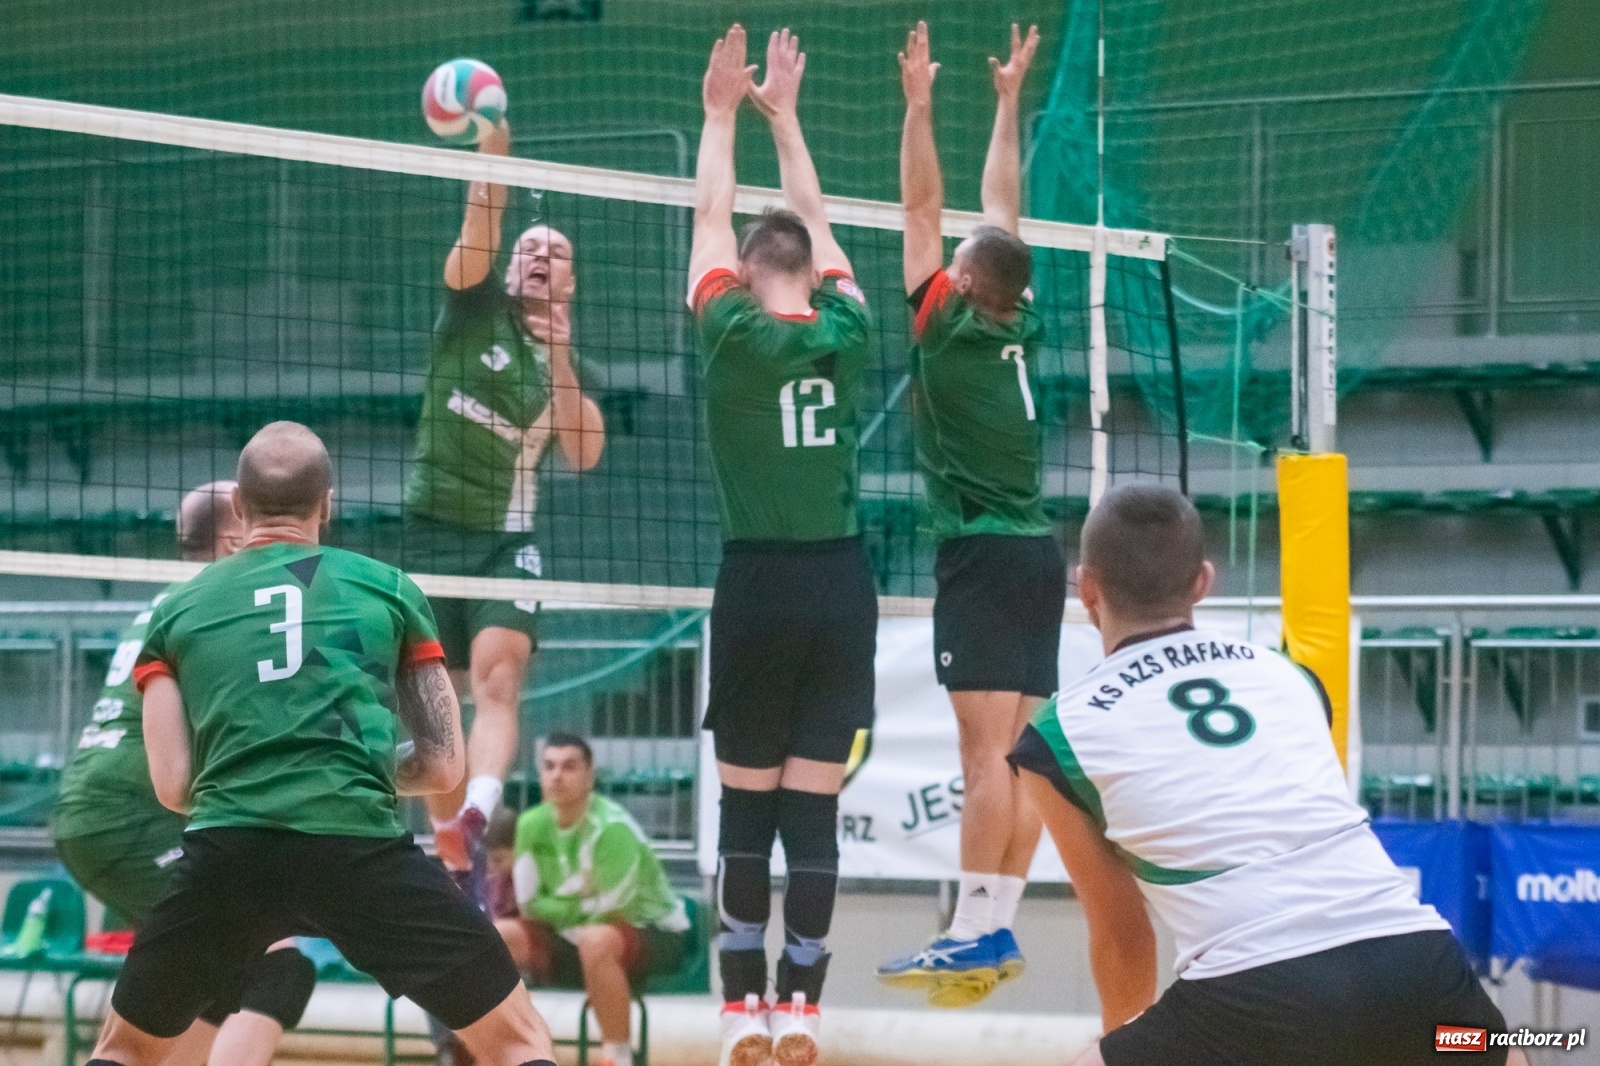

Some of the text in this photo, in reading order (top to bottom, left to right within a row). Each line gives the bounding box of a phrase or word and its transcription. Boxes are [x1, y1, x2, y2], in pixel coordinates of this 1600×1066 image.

[779, 378, 836, 448] 12
[254, 584, 303, 683] 3
[1087, 641, 1256, 711] KS AZS RAFAKO
[1167, 677, 1257, 748] 8
[1516, 868, 1600, 903] molt
